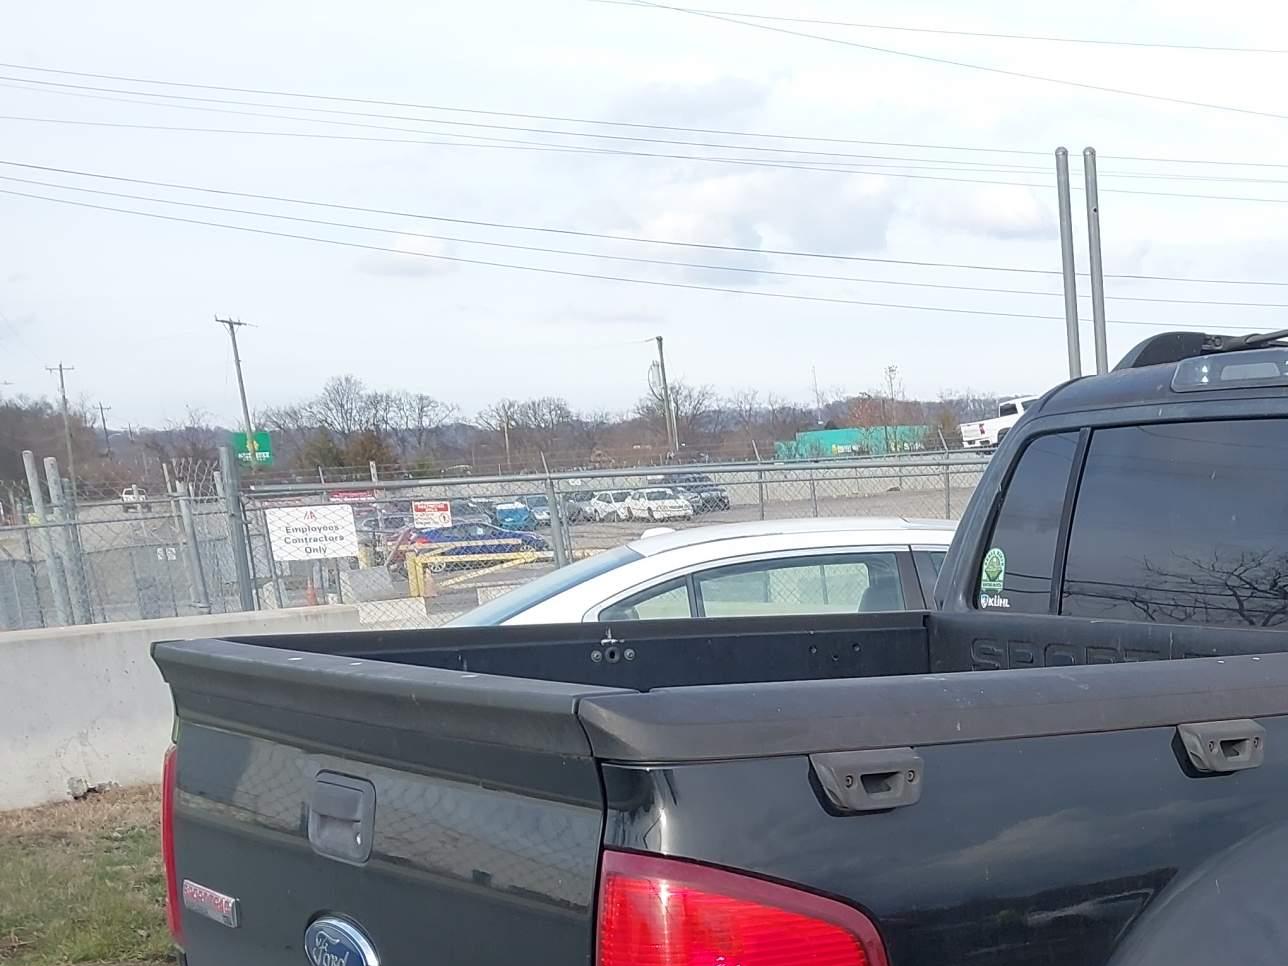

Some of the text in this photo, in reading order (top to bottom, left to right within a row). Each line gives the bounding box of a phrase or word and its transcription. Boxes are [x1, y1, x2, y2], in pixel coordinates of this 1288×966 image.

[285, 525, 340, 534] Employees
[284, 534, 344, 545] Contractors
[304, 546, 327, 554] Only
